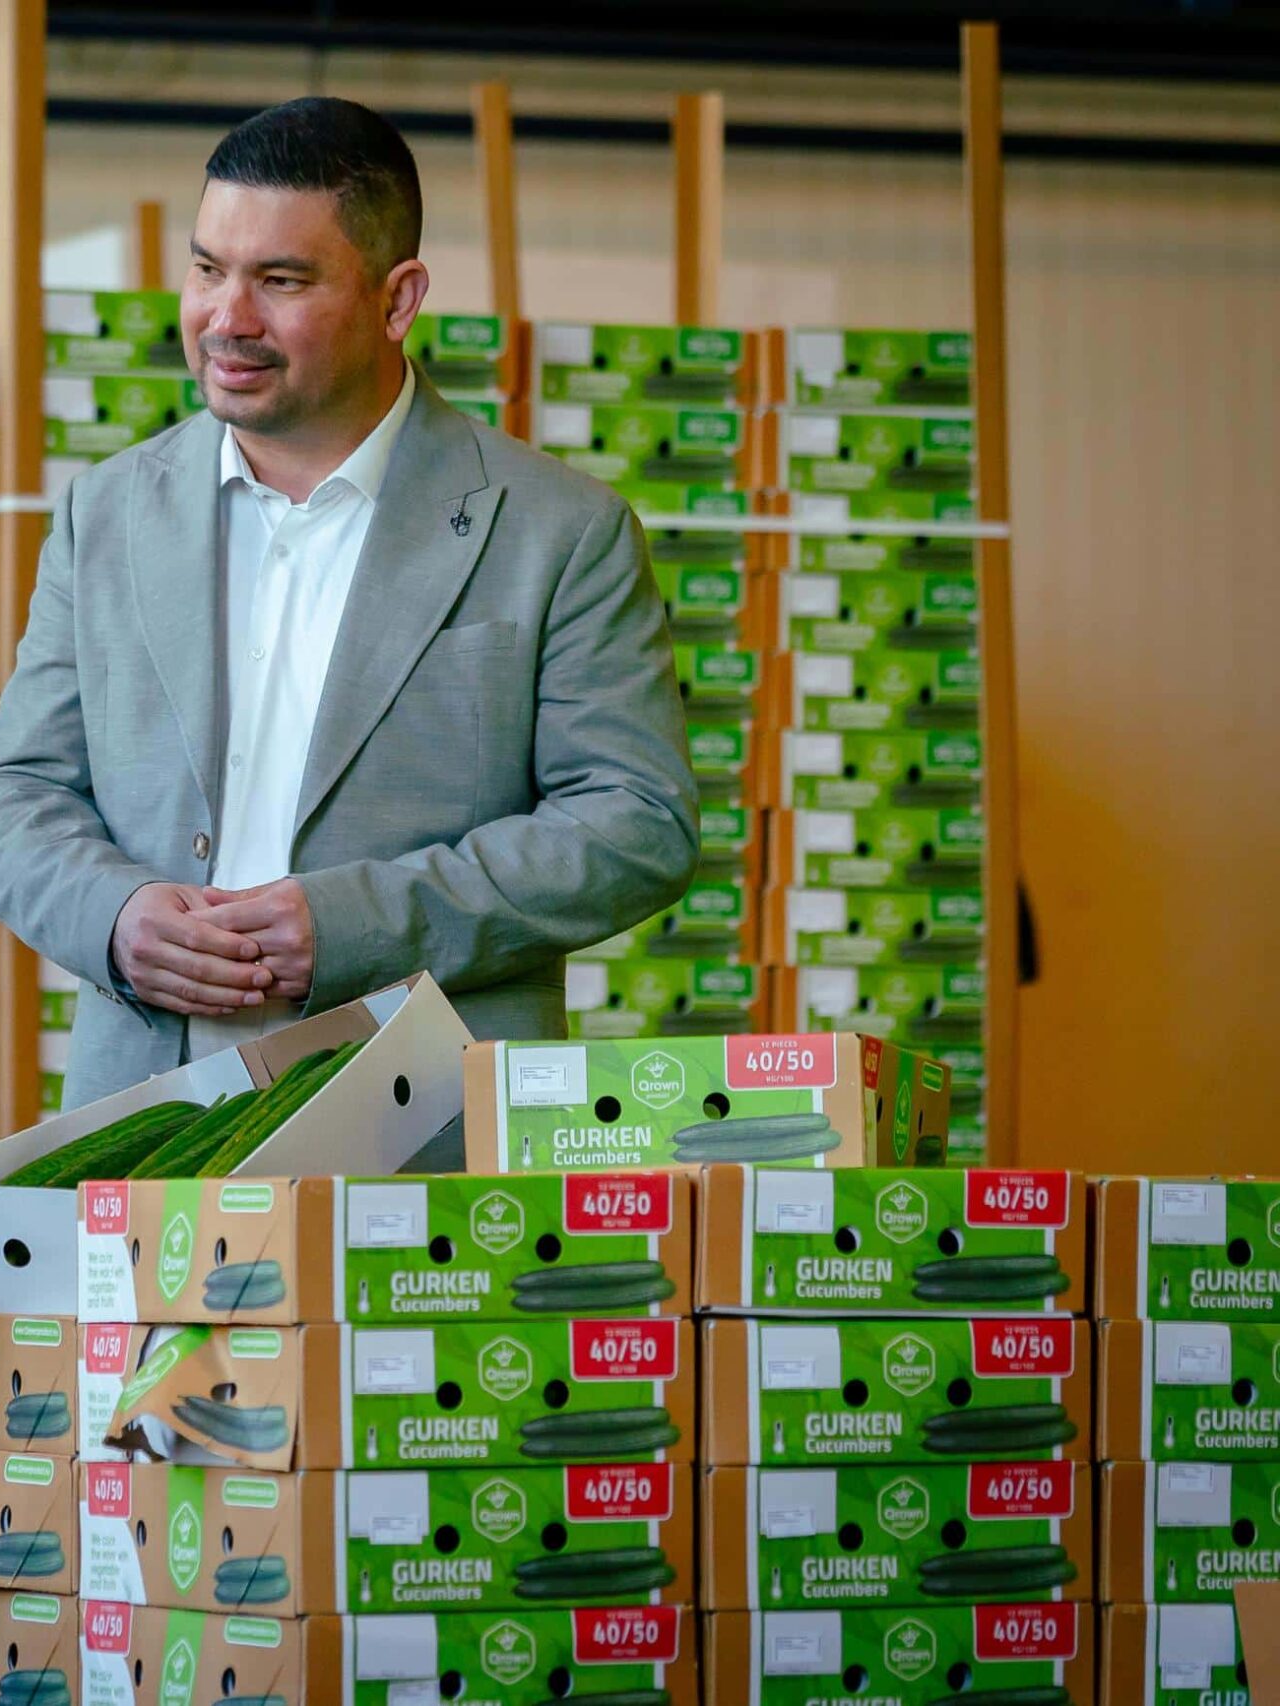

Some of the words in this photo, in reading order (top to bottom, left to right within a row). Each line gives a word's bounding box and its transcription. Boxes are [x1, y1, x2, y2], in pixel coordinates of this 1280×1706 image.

[746, 1050, 814, 1073] 40/50
[638, 1080, 680, 1093] Qrown
[553, 1126, 652, 1150] GURKEN
[553, 1150, 642, 1166] Cucumbers
[93, 1197, 122, 1218] 40/50
[583, 1193, 652, 1216] 40/50
[984, 1187, 1049, 1210] 40/50
[796, 1258, 892, 1282] GURKEN
[391, 1271, 491, 1295] GURKEN
[796, 1283, 882, 1299] Cucumbers
[391, 1297, 481, 1312] Cucumbers
[1190, 1292, 1274, 1309] Cucumbers
[92, 1336, 120, 1358] 40/50
[590, 1339, 657, 1362] 40/50
[990, 1336, 1055, 1359] 40/50
[399, 1417, 499, 1440] GURKEN
[805, 1413, 902, 1438] GURKEN
[398, 1442, 489, 1458] Cucumbers
[805, 1438, 892, 1454] Cucumbers
[1195, 1432, 1278, 1449] Cucumbers
[95, 1479, 124, 1501] 40/50
[584, 1479, 651, 1503] 40/50
[987, 1478, 1053, 1501] 40/50
[392, 1560, 492, 1584] GURKEN
[802, 1558, 898, 1580] GURKEN
[392, 1586, 482, 1601] Cucumbers
[802, 1582, 889, 1598] Cucumbers
[92, 1614, 123, 1638] 40/50
[593, 1621, 659, 1645] 40/50
[993, 1620, 1057, 1642] 40/50
